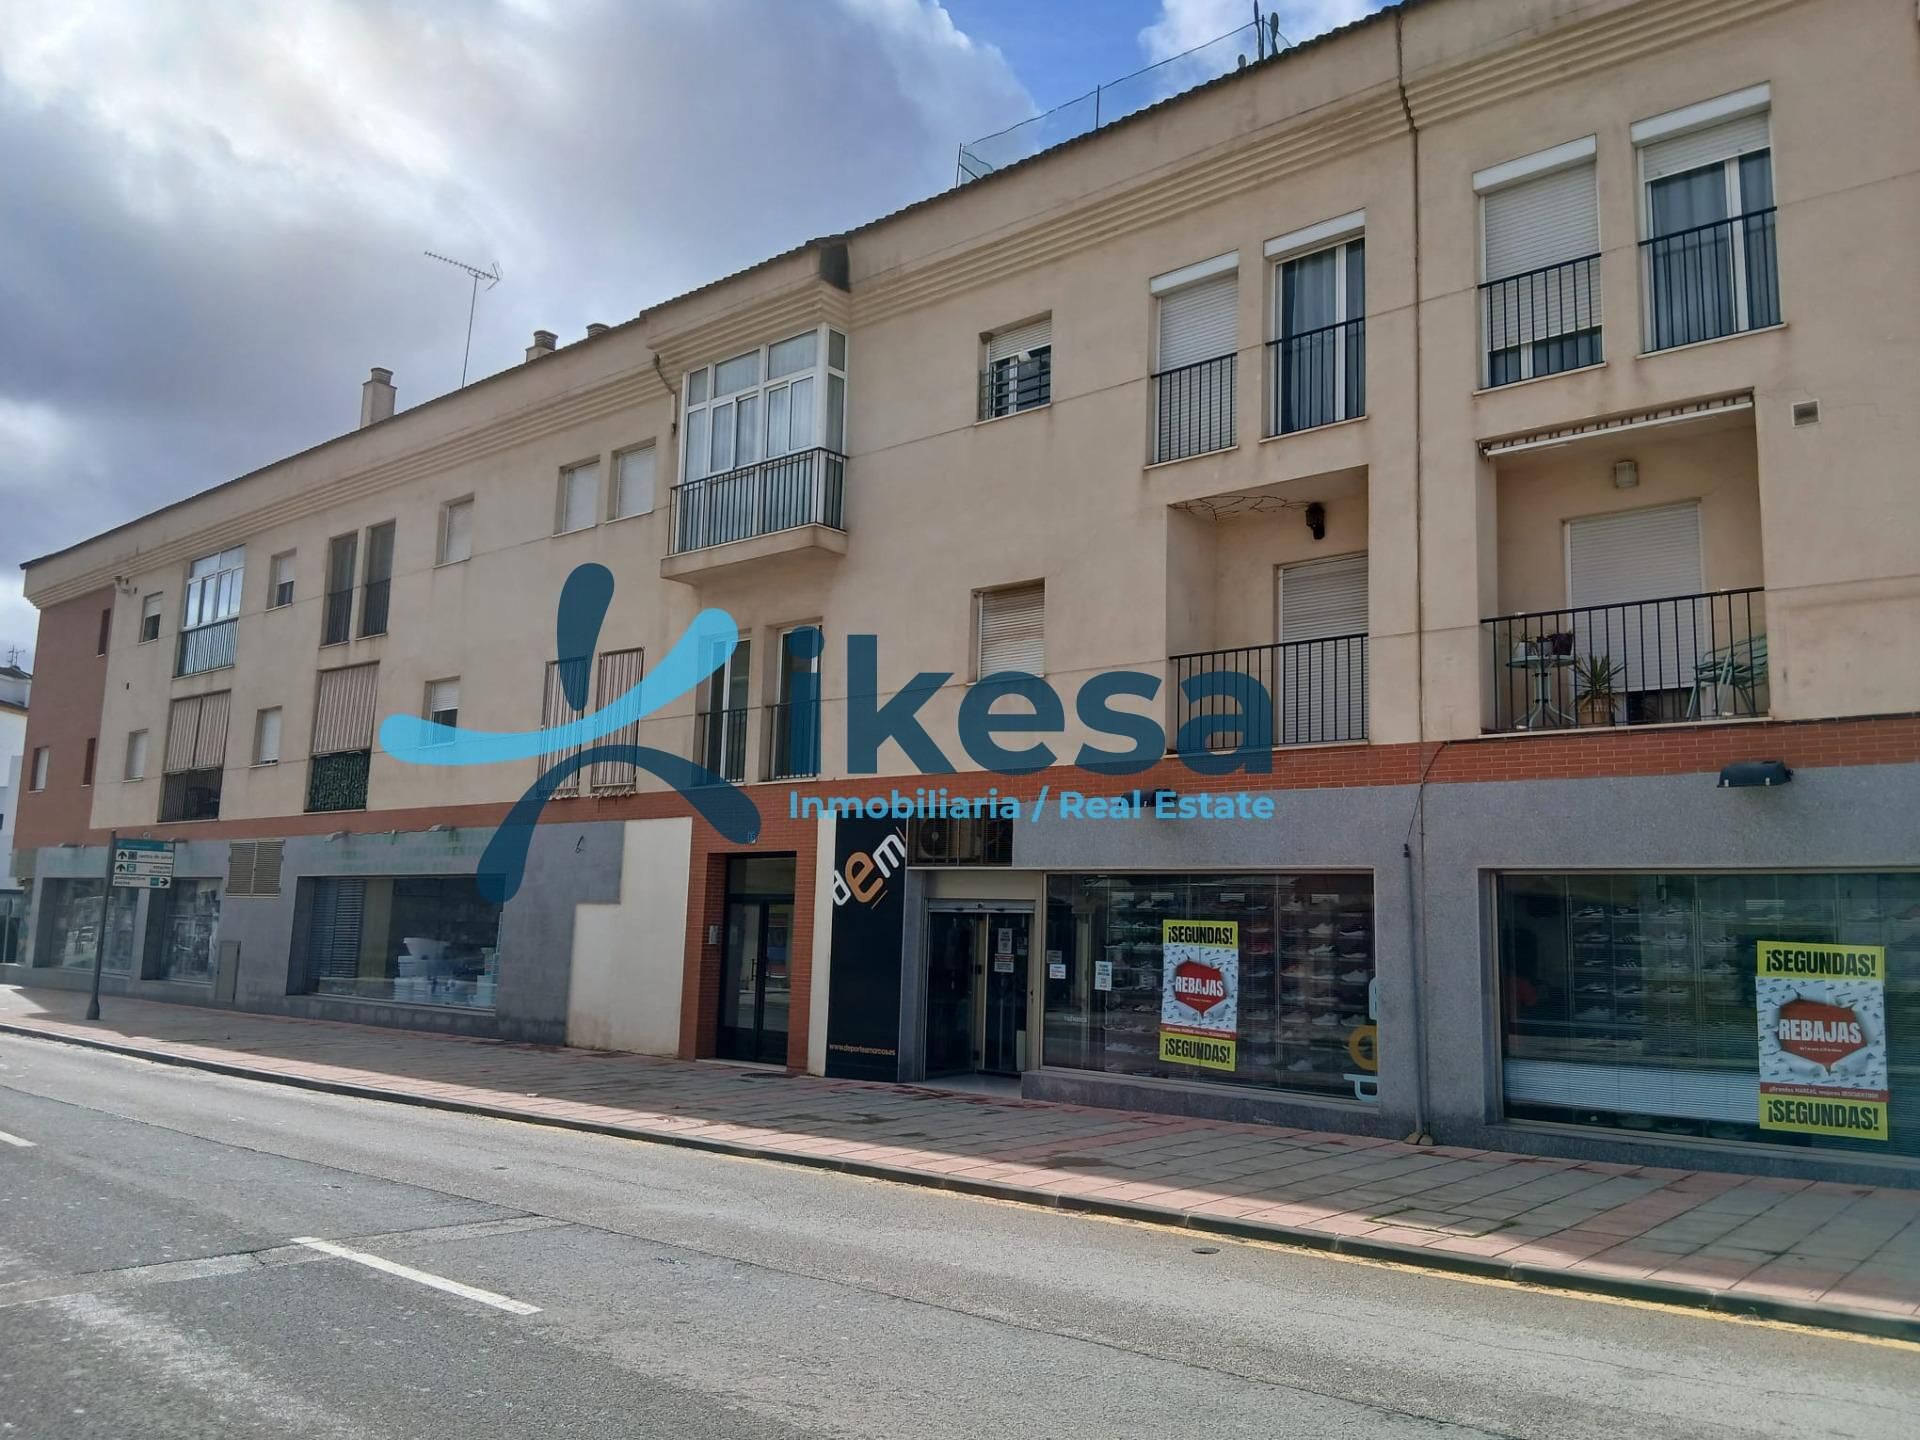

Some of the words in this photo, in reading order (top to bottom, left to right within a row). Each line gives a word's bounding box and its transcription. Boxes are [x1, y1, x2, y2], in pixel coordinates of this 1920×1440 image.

[1168, 925, 1233, 945] ¡SEGUNDAS!
[1766, 949, 1876, 977] ¡SEGUNDAS!
[1175, 975, 1224, 997] REBAJAS
[1779, 1018, 1862, 1044] REBAJAS
[1165, 1038, 1230, 1064] ¡SEGUNDAS!
[1768, 1100, 1879, 1130] ¡SEGUNDAS!
